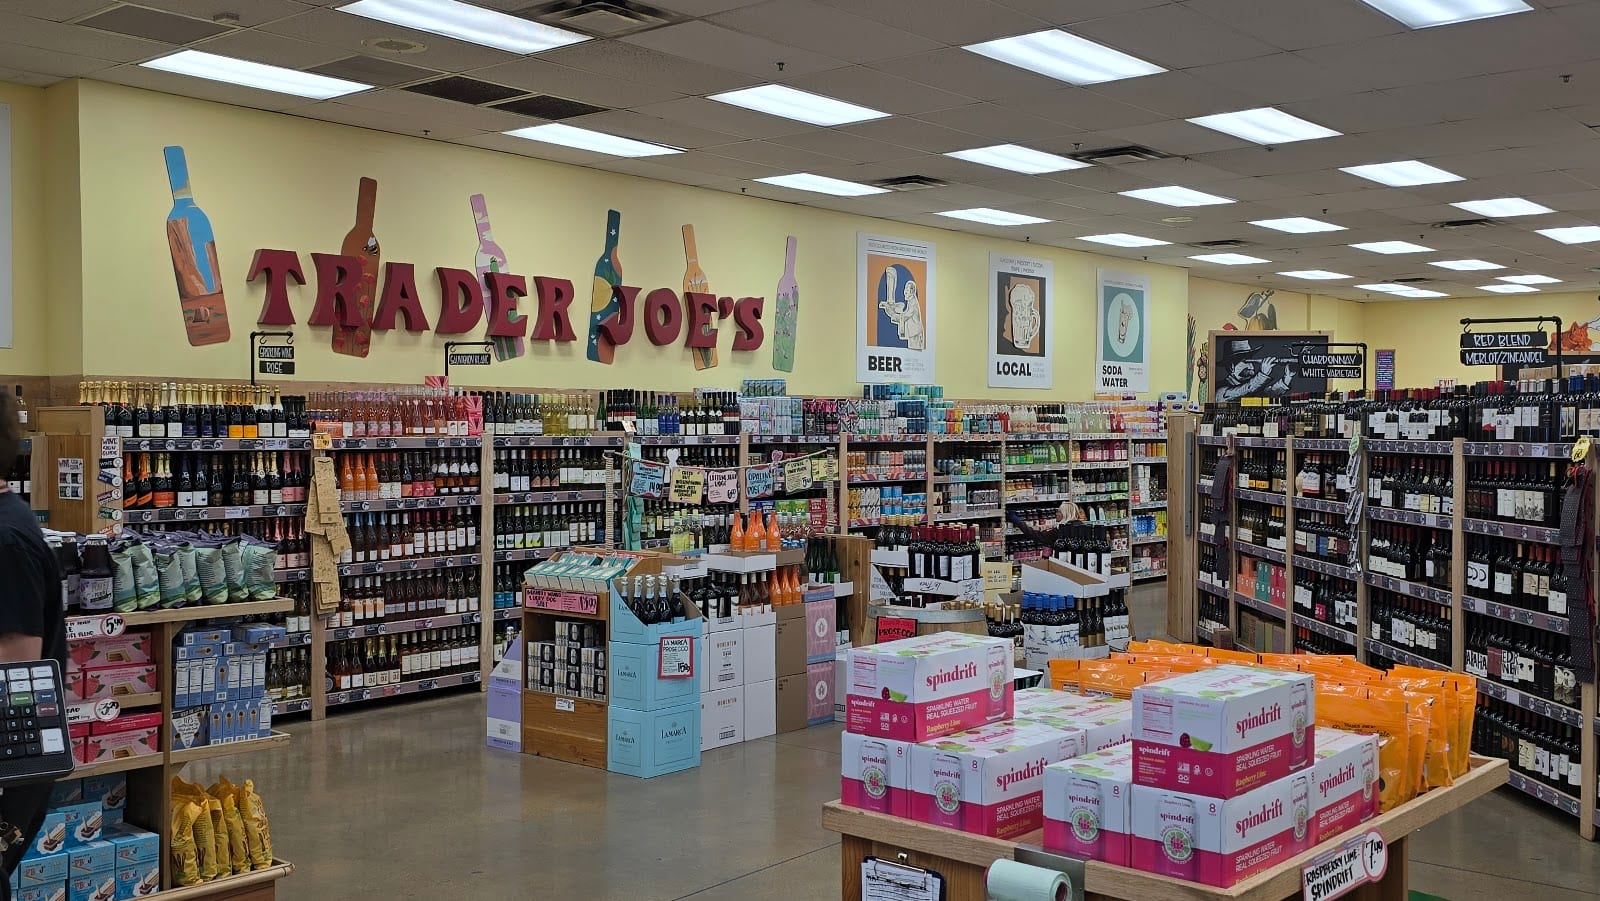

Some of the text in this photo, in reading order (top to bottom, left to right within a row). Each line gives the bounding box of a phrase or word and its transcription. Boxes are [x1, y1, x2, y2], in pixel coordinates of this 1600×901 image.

[246, 249, 764, 351] TRADER JOE'S
[1473, 334, 1531, 346] RED BLEND
[868, 356, 902, 372] BEER
[1302, 355, 1357, 365] CHARDONNAY
[1465, 351, 1545, 364] MERLOT/ZINFANDEL
[266, 362, 283, 373] ROSE
[996, 361, 1032, 376] LOCAL
[1102, 365, 1122, 376] SODA
[1302, 368, 1360, 378] WHITE VARIETALS
[1102, 377, 1128, 388] WATER
[926, 661, 977, 691] spindrift
[927, 697, 970, 712] SPARKLING WATER
[927, 702, 977, 720] REAL SQUEEZED FRUIT
[926, 722, 950, 732] Raspberry
[1236, 702, 1282, 738] spindrift
[897, 746, 903, 755] 8
[1139, 746, 1171, 757] spindrift
[1236, 744, 1275, 764] SPARKLING WATER
[972, 760, 978, 769] 8
[1236, 749, 1282, 772] REAL SQUEEZED FRUIT
[1235, 773, 1257, 788] Raspberry
[1319, 763, 1355, 798] spindrift
[1113, 785, 1120, 795] 8
[997, 800, 1024, 815] SPARKLING
[1024, 795, 1041, 806] WATER
[1068, 794, 1100, 806] spindrift
[997, 812, 1010, 822] REAL
[1010, 803, 1035, 818] SQUEEZED
[1209, 803, 1216, 813] 8
[1319, 807, 1338, 820] SPARKLING
[1160, 812, 1195, 825] spindrift
[1235, 798, 1283, 839] spindrift
[1236, 841, 1275, 864] SPARKLING WATER
[1236, 845, 1283, 872] REAL SQUEEZED FRUIT
[1306, 855, 1343, 886] RASPBERRY
[1310, 863, 1354, 901] SPINDRIFT
